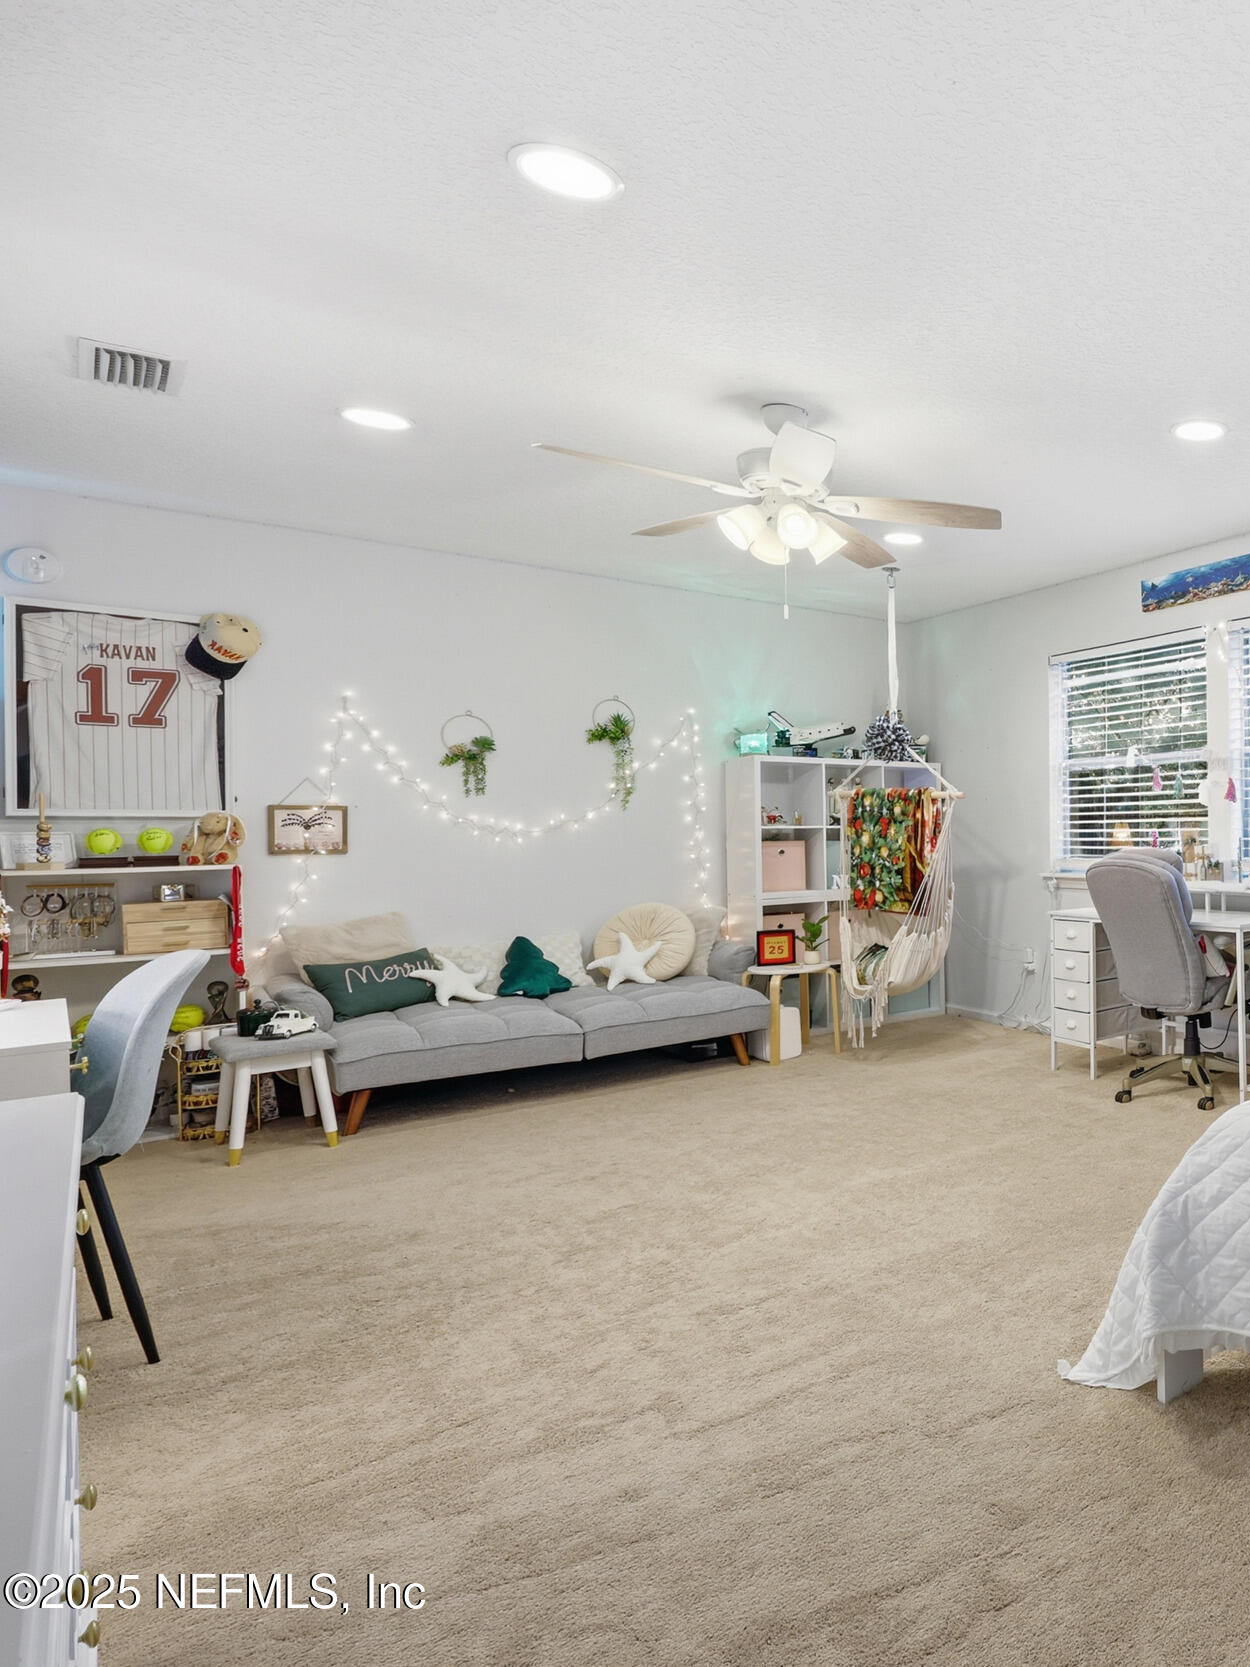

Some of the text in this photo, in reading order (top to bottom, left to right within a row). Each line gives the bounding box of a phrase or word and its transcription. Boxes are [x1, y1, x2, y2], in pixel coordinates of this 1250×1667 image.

[99, 643, 156, 662] KAVAN
[75, 664, 181, 728] 17
[768, 945, 784, 955] 25
